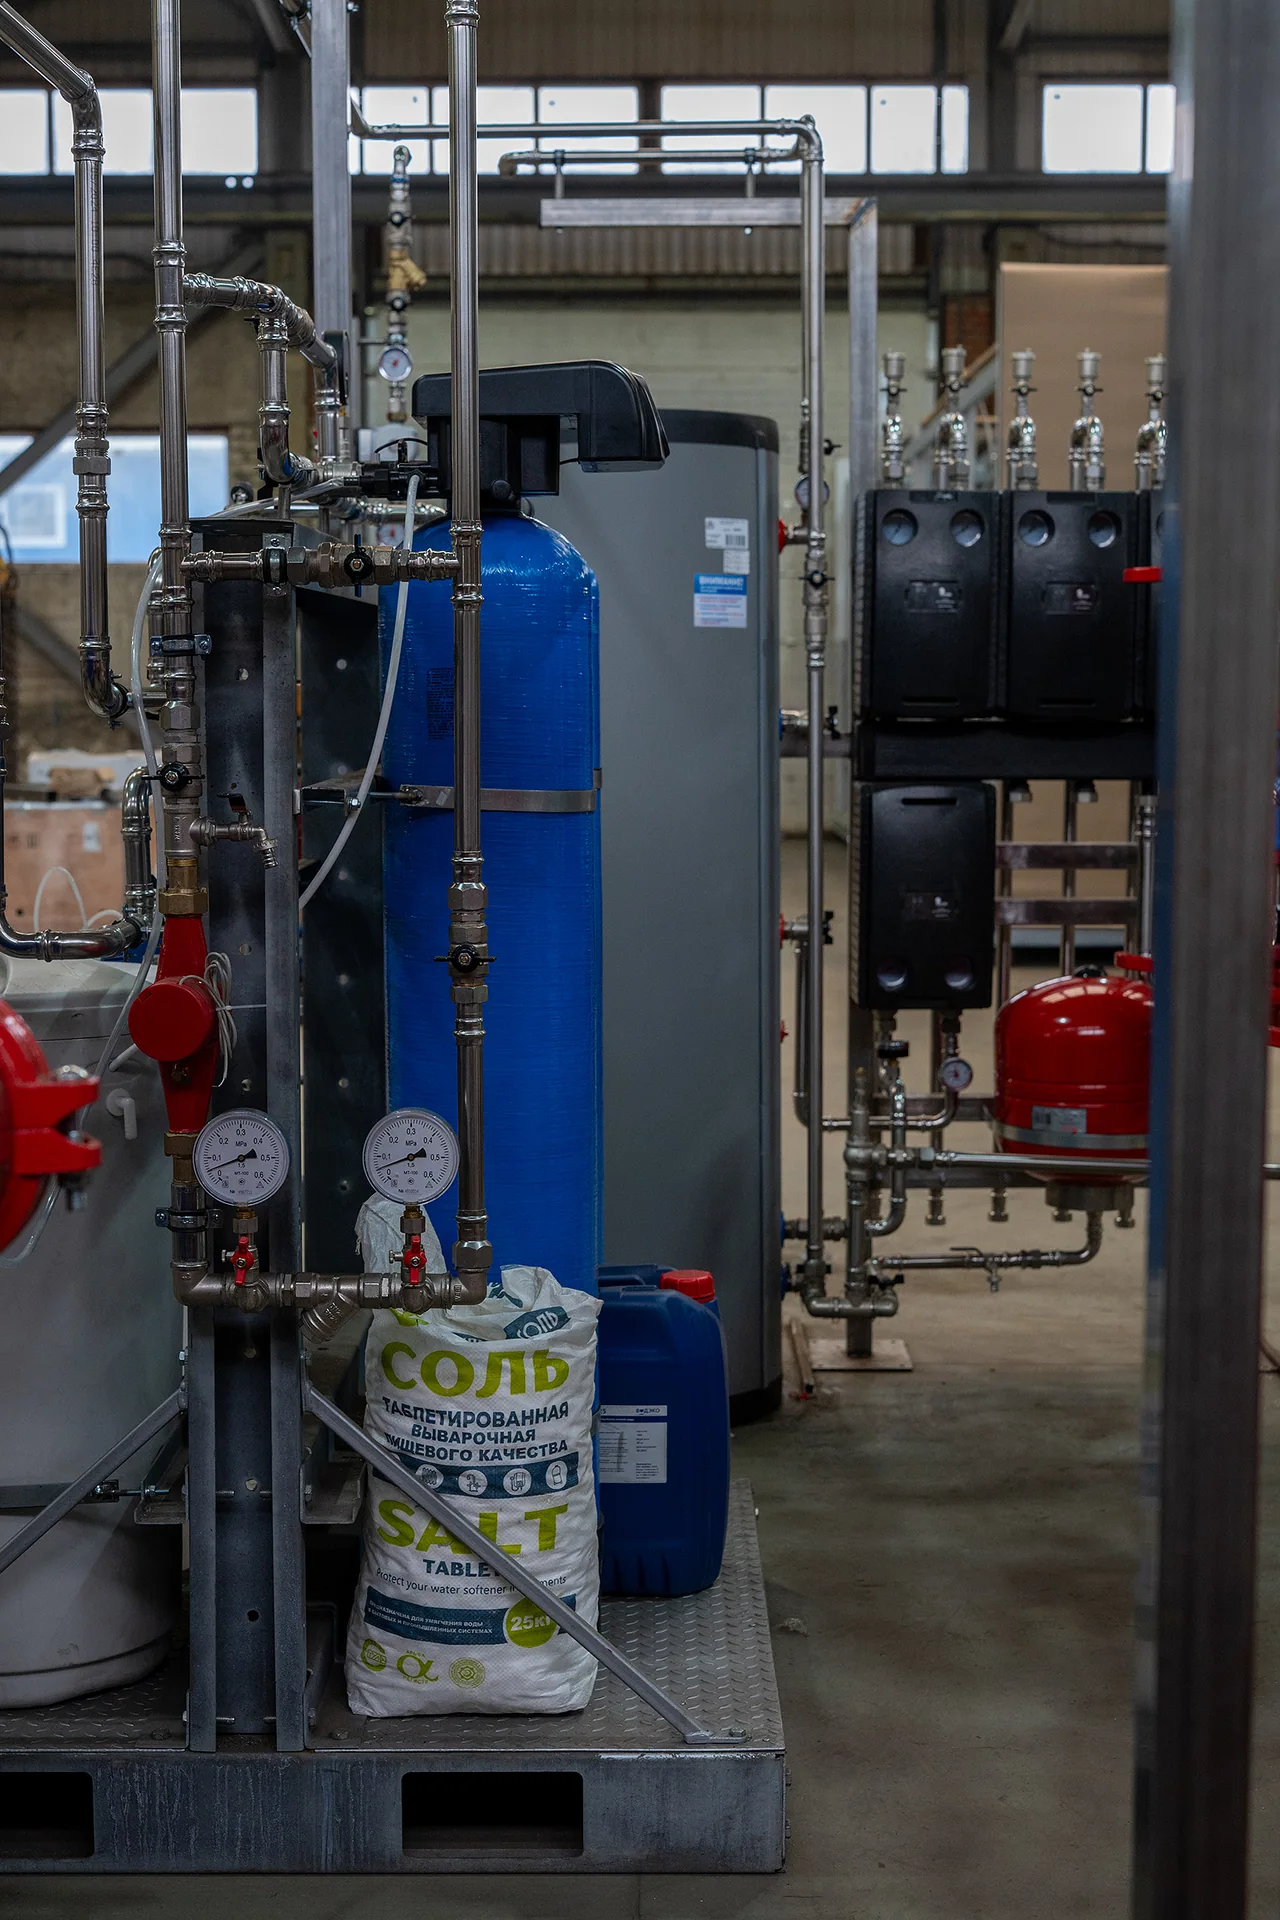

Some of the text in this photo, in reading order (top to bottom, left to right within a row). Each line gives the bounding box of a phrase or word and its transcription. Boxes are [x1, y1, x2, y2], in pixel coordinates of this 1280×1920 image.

[219, 1137, 229, 1145] 0,2
[253, 1137, 263, 1145] 0,4
[389, 1136, 399, 1144] 0,2
[212, 1154, 221, 1162] 0,1
[261, 1154, 271, 1162] 0,5
[254, 1171, 264, 1179] 0,6
[423, 1170, 433, 1178] 0,6
[382, 1341, 570, 1398] СОЛЬ
[382, 1396, 569, 1428] ТАБЛЕТИРОВАННАЯ
[412, 1424, 536, 1445] ВЫВАРОЧНАЯ
[384, 1432, 568, 1461] ПИЩЕВОГО КАЧЕСТВА
[377, 1500, 568, 1555] SALT
[423, 1559, 503, 1577] TABLE
[376, 1567, 404, 1586] Protect
[405, 1580, 428, 1590] your
[431, 1584, 460, 1594] water
[463, 1583, 506, 1595] softener
[403, 1620, 457, 1634] ПРОМЫШЛЕННЫХ
[457, 1627, 493, 1635] СИСТЕМАХ
[410, 1615, 424, 1623] ДЛЯ
[425, 1617, 462, 1627] УМЯГЧЕНИЯ
[463, 1620, 484, 1628] ВОДЫ
